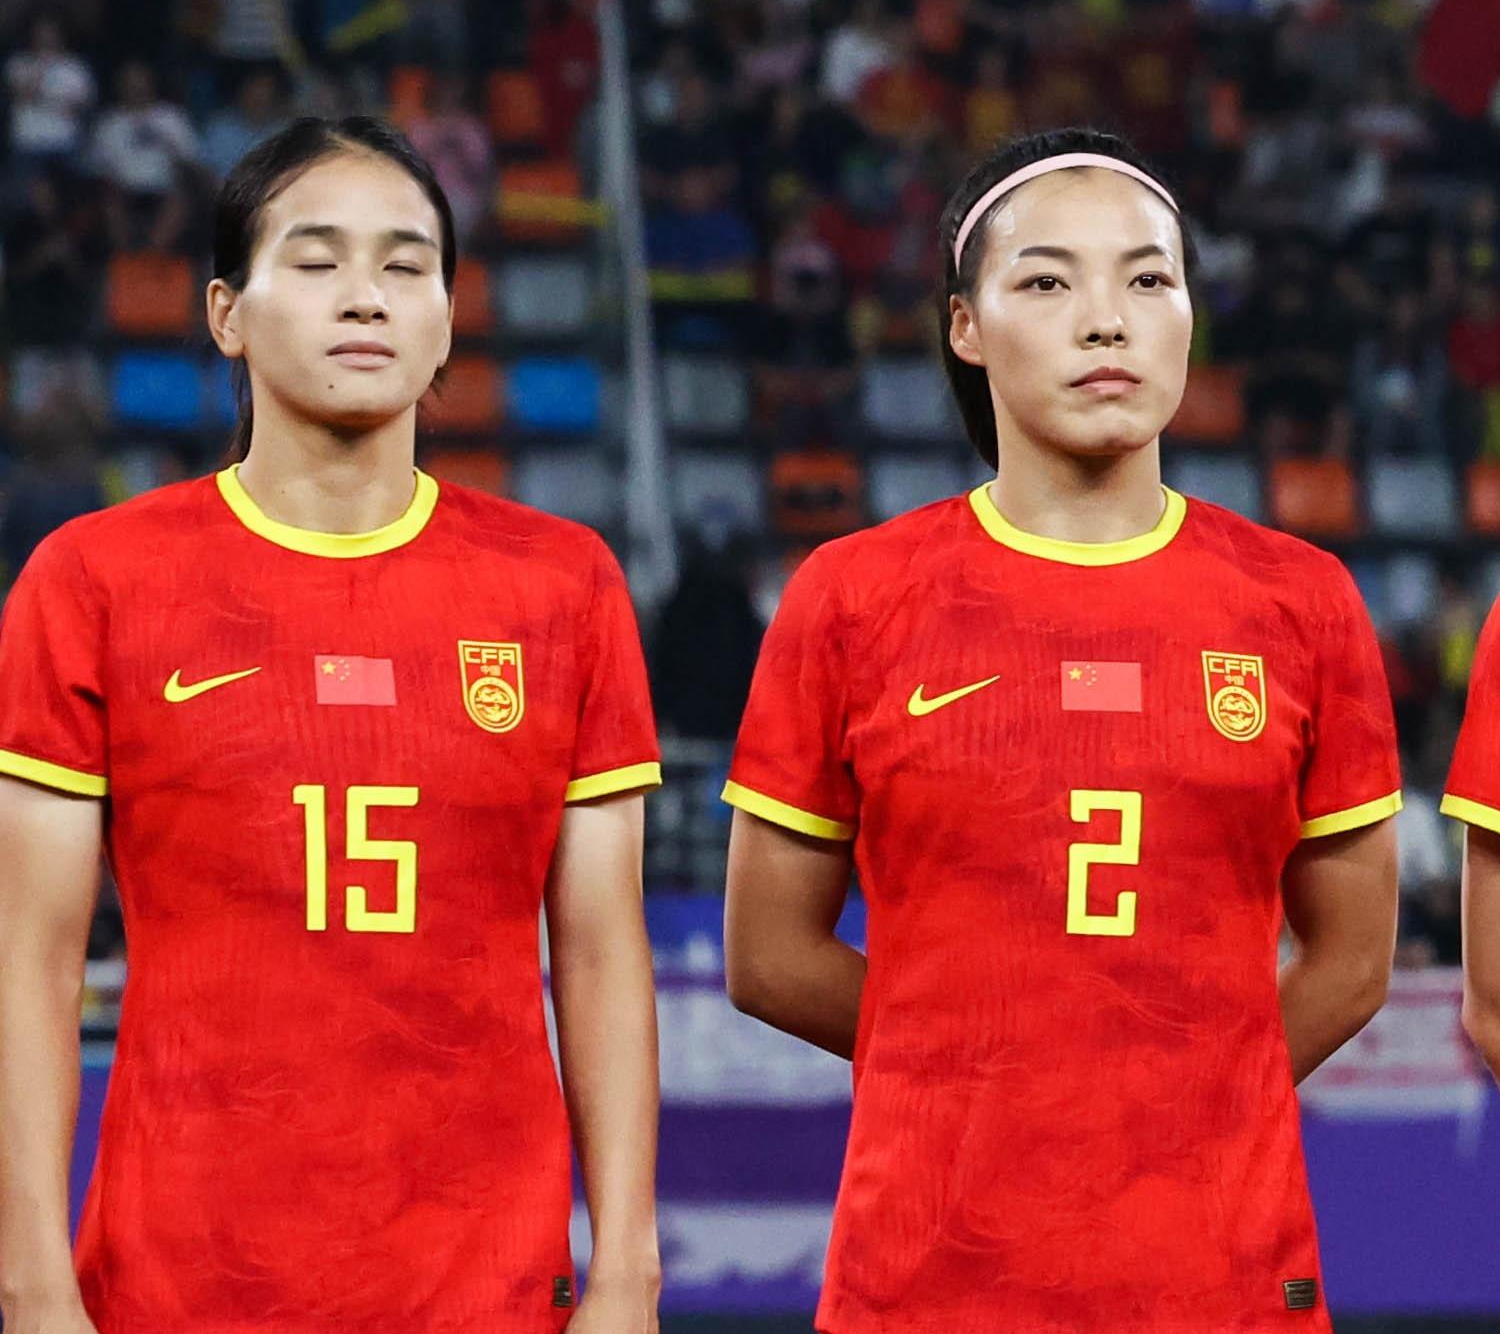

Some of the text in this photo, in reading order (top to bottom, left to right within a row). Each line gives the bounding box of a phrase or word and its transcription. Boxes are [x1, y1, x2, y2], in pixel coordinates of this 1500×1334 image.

[464, 647, 516, 665] CFA
[1208, 658, 1257, 677] CFA
[293, 784, 420, 933] 15
[1066, 788, 1142, 936] 2
